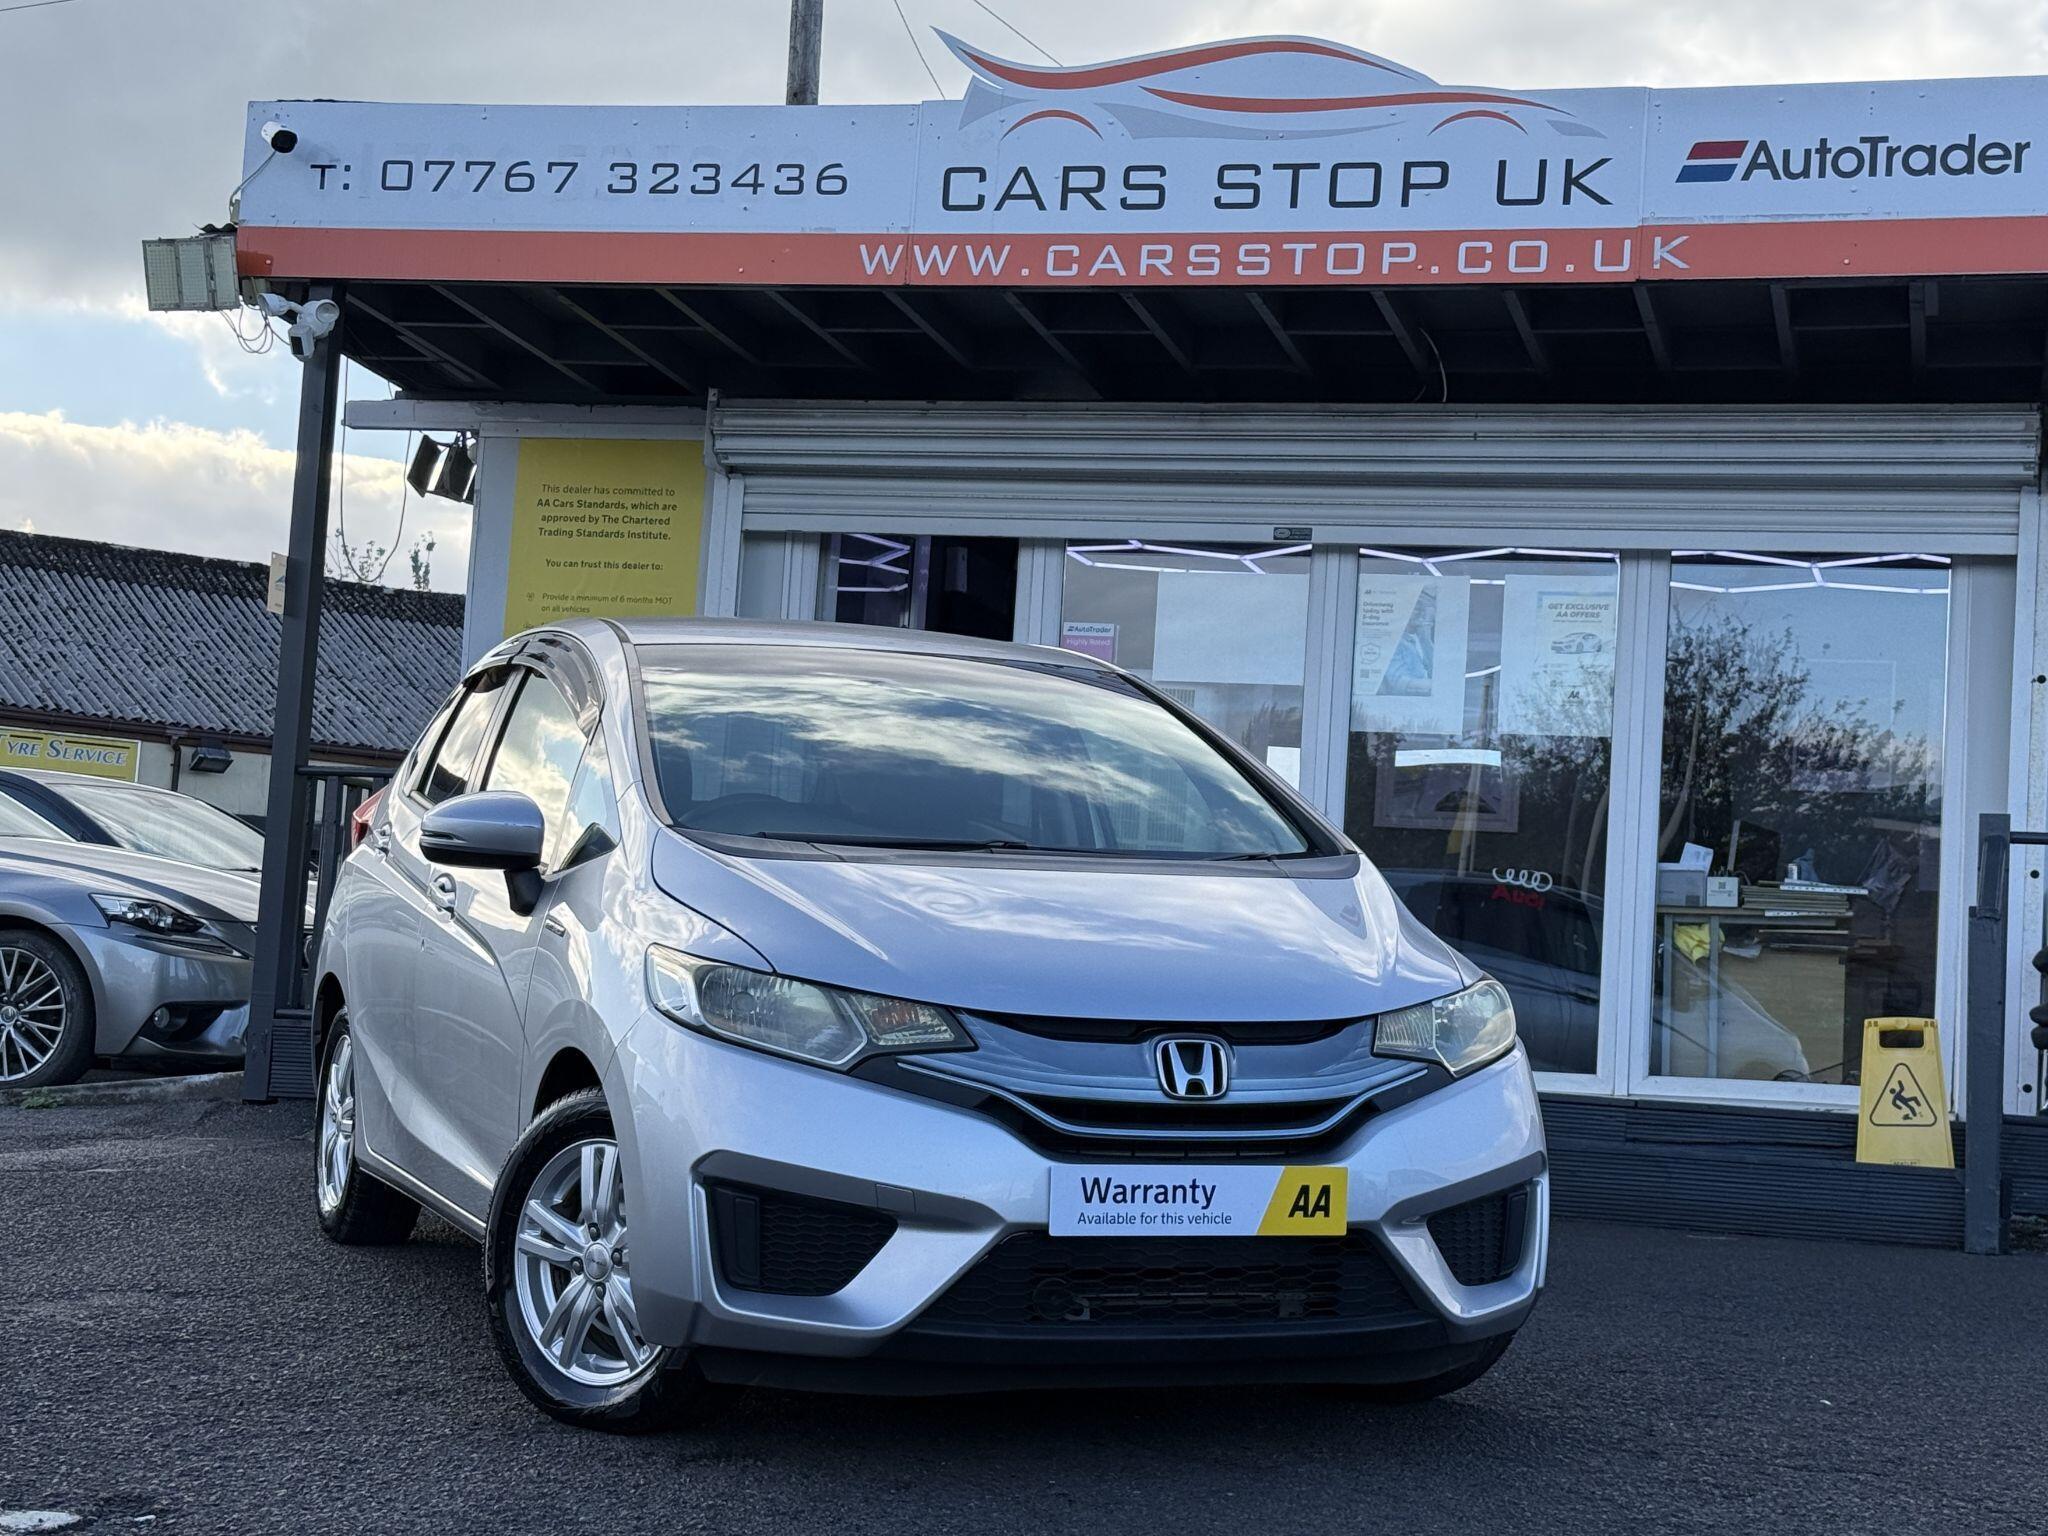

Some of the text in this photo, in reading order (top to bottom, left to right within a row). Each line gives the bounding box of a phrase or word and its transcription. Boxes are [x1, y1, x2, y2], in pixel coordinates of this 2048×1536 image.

[1741, 133, 2031, 182] AutoTrader
[310, 160, 849, 195] T: 07767 323436
[942, 157, 1614, 211] CARS STOP UK
[860, 234, 1690, 278] WWW.CARSSTOP.CO.UK
[542, 484, 676, 497] This dealer has committed to
[537, 498, 678, 511] AA Cars Standards, which are
[541, 514, 671, 526] approved by The Chartered
[538, 527, 671, 541] Trading Standards Institute.
[546, 558, 562, 568] You
[563, 561, 579, 569] can
[580, 560, 602, 569] trust
[604, 561, 620, 570] this
[622, 561, 649, 571] dealer
[542, 592, 569, 601] Provide
[1548, 602, 1610, 611] GET EXCLUSIVE
[1570, 611, 1601, 619] OFFERS
[1081, 1176, 1332, 1219] Warranty AA
[1077, 1211, 1233, 1226] Available for this vehicle
